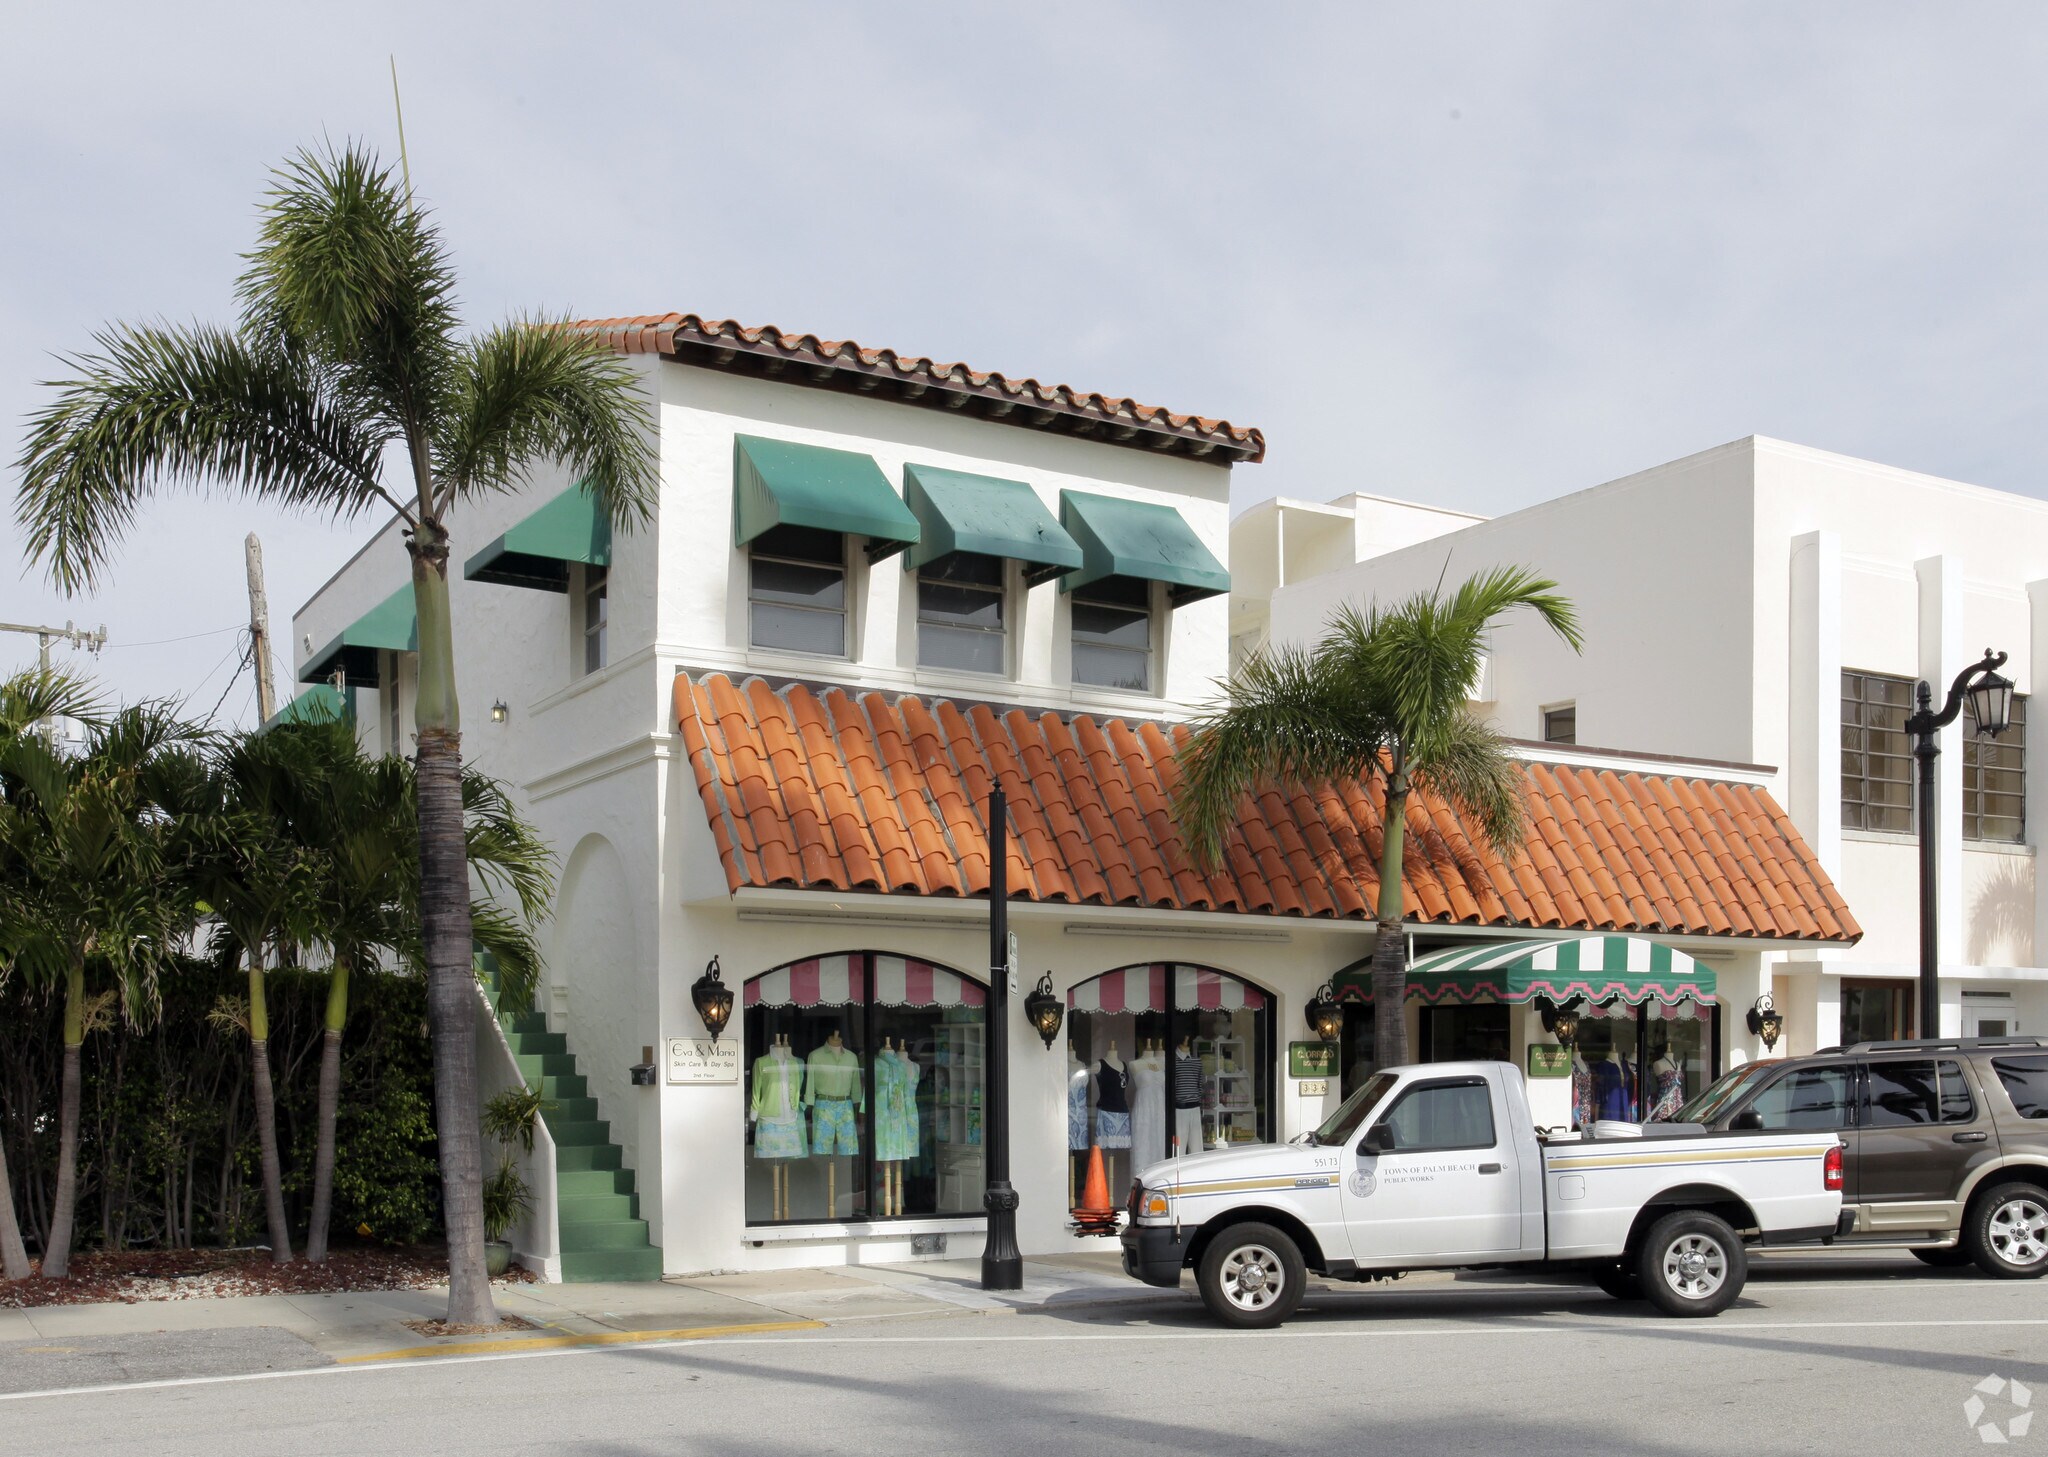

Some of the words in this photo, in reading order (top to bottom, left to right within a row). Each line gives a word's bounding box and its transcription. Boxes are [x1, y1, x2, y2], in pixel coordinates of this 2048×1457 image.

[672, 1043, 693, 1057] Eva
[695, 1044, 705, 1057] &
[708, 1044, 736, 1057] Maria
[1410, 1166, 1421, 1174] OF
[1423, 1165, 1446, 1173] PALM
[1448, 1164, 1475, 1172] BEACH
